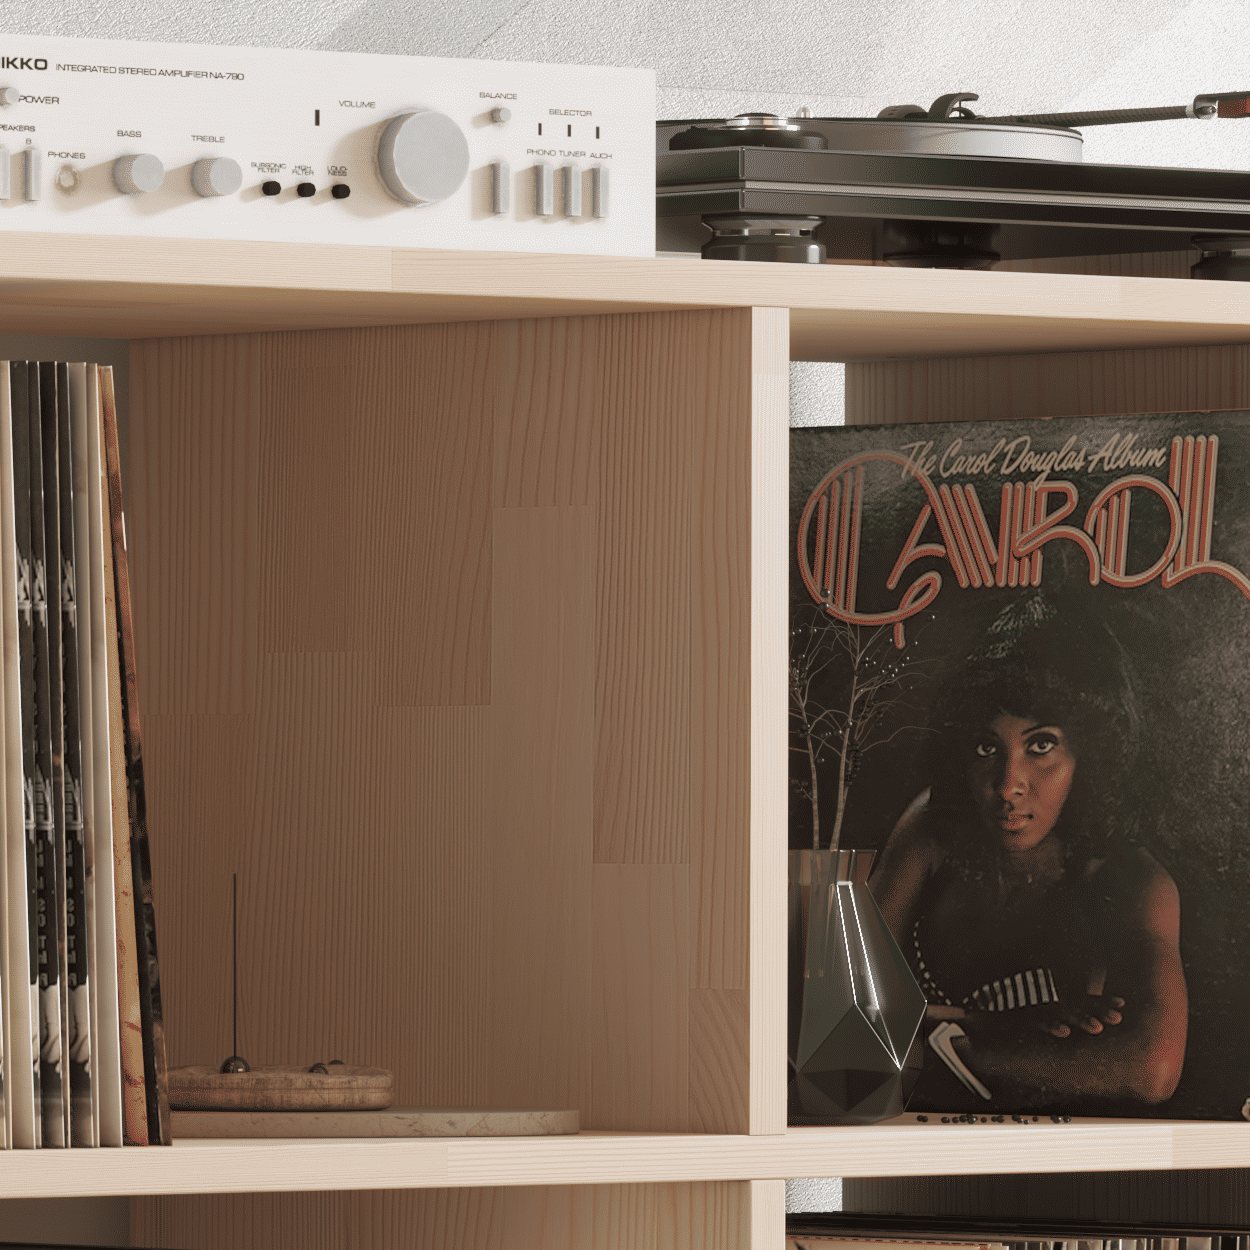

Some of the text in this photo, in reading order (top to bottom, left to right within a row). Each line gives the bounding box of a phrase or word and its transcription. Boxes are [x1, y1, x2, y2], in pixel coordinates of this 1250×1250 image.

[55, 63, 117, 75] INTEGRATED
[118, 66, 157, 77] STEREO
[158, 68, 209, 79] AMPLIFIER
[18, 94, 60, 105] POWER
[478, 91, 518, 101] BALANCE
[338, 99, 376, 109] VOLUME
[548, 108, 593, 117] SELECTOR
[116, 129, 143, 138] BASS
[25, 137, 33, 145] B
[190, 134, 226, 144] TREBLE
[47, 150, 86, 160] PHONES
[526, 148, 557, 157] PHONO
[558, 149, 588, 158] TUNER
[899, 432, 1167, 491] The Carol Douglas Album
